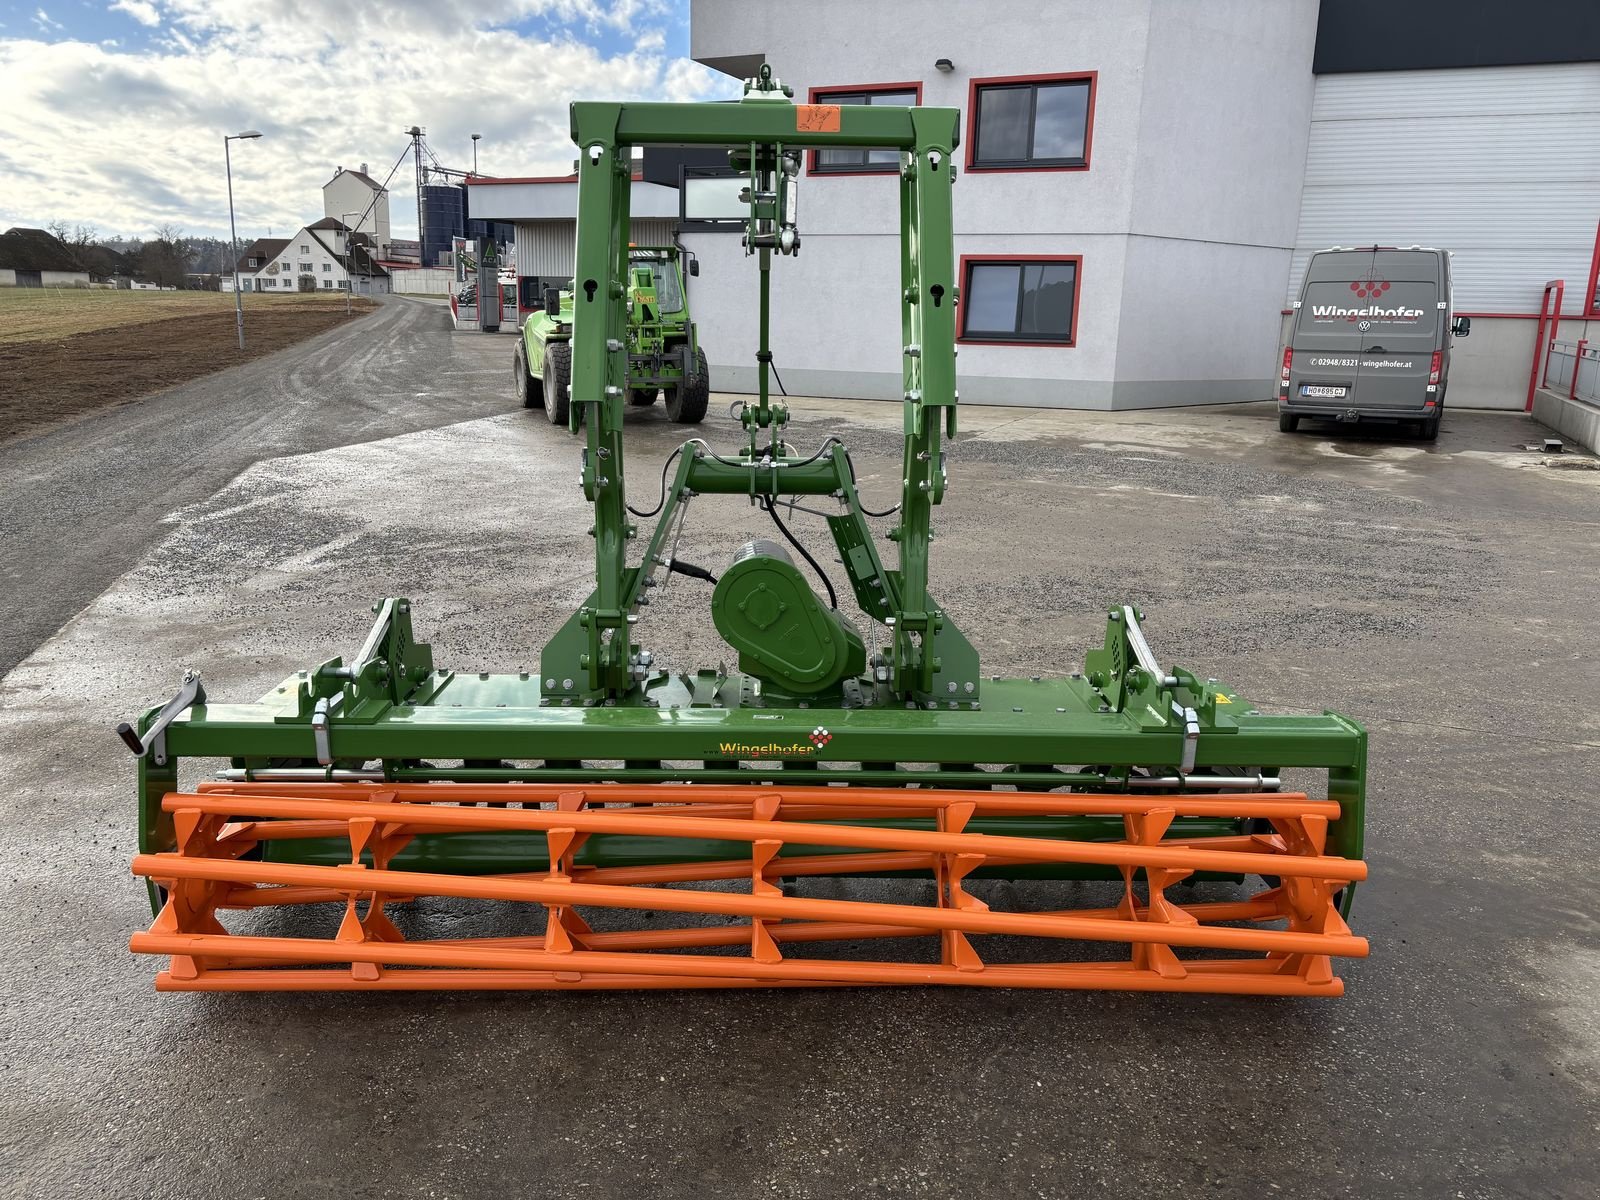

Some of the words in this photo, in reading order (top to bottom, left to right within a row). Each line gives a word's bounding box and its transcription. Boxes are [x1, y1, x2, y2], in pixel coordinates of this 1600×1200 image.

[1312, 305, 1424, 324] Wingelhofer
[1318, 358, 1358, 366] 02948/8321
[1362, 360, 1412, 368] wingelhofer.at
[720, 742, 814, 757] Wingelhofer
